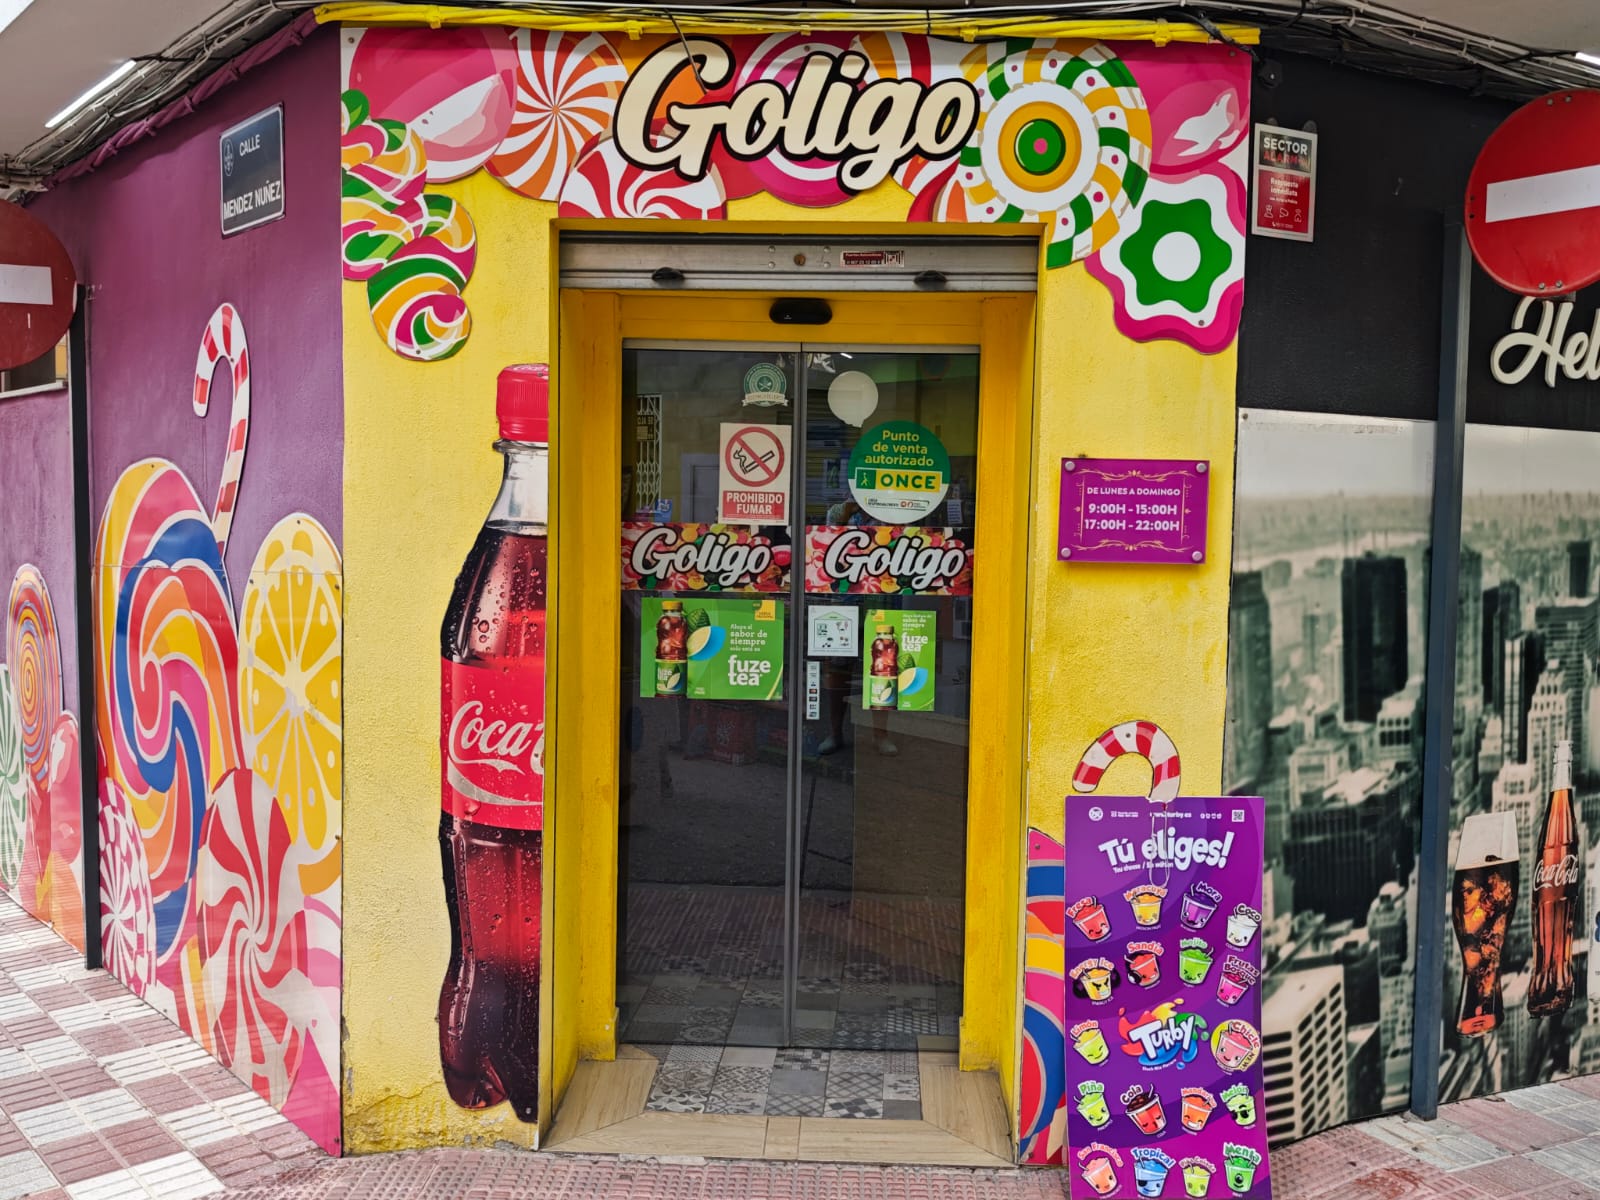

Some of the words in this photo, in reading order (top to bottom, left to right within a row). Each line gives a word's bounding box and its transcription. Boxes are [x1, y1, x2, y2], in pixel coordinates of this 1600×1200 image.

[615, 38, 979, 192] Goligo
[239, 134, 261, 157] CALLE
[1263, 136, 1308, 155] SECTOR
[223, 191, 253, 220] MENDEZ
[254, 179, 281, 208] NUÑEZ
[882, 430, 920, 442] Punto
[872, 441, 889, 453] de
[892, 444, 928, 455] venta
[864, 454, 935, 467] autorizado
[880, 473, 937, 490] ONCE
[1086, 486, 1099, 495] DE
[1100, 487, 1128, 496] LUNES
[1128, 487, 1136, 496] A
[1136, 487, 1181, 496] DOMINGO
[726, 491, 783, 504] PROHIBIDO
[736, 503, 773, 515] FUMAR
[1088, 503, 1127, 515] 9:00H
[1135, 503, 1178, 516] 15:00H
[1084, 519, 1127, 531] 17:00H
[1135, 520, 1180, 532] 22:00H
[631, 526, 772, 587] Goligo
[825, 530, 966, 590] Goligo
[729, 629, 755, 639] sabor
[756, 629, 768, 639] de
[729, 637, 767, 648] siempre
[902, 631, 929, 645] fuze
[727, 655, 772, 674] fuze
[727, 670, 761, 687] tea
[1098, 838, 1136, 867] Tú
[1141, 826, 1235, 871] eliges!
[1196, 881, 1222, 902] Mora
[1066, 896, 1093, 919] Fresa
[1236, 903, 1262, 922] Coco
[1127, 941, 1164, 956] Sandía
[1069, 957, 1099, 980] Energy
[1098, 957, 1115, 971] Ice
[1223, 962, 1256, 986] Bosque
[1227, 954, 1260, 977] Frutas
[1070, 1019, 1098, 1037] Limón
[1232, 1021, 1261, 1049] Chicle
[1077, 1080, 1105, 1096] Piña
[1120, 1084, 1143, 1105] Cola
[1077, 1146, 1093, 1160] San
[1131, 1147, 1176, 1169] Tropical
[1223, 1141, 1262, 1166] Menta
